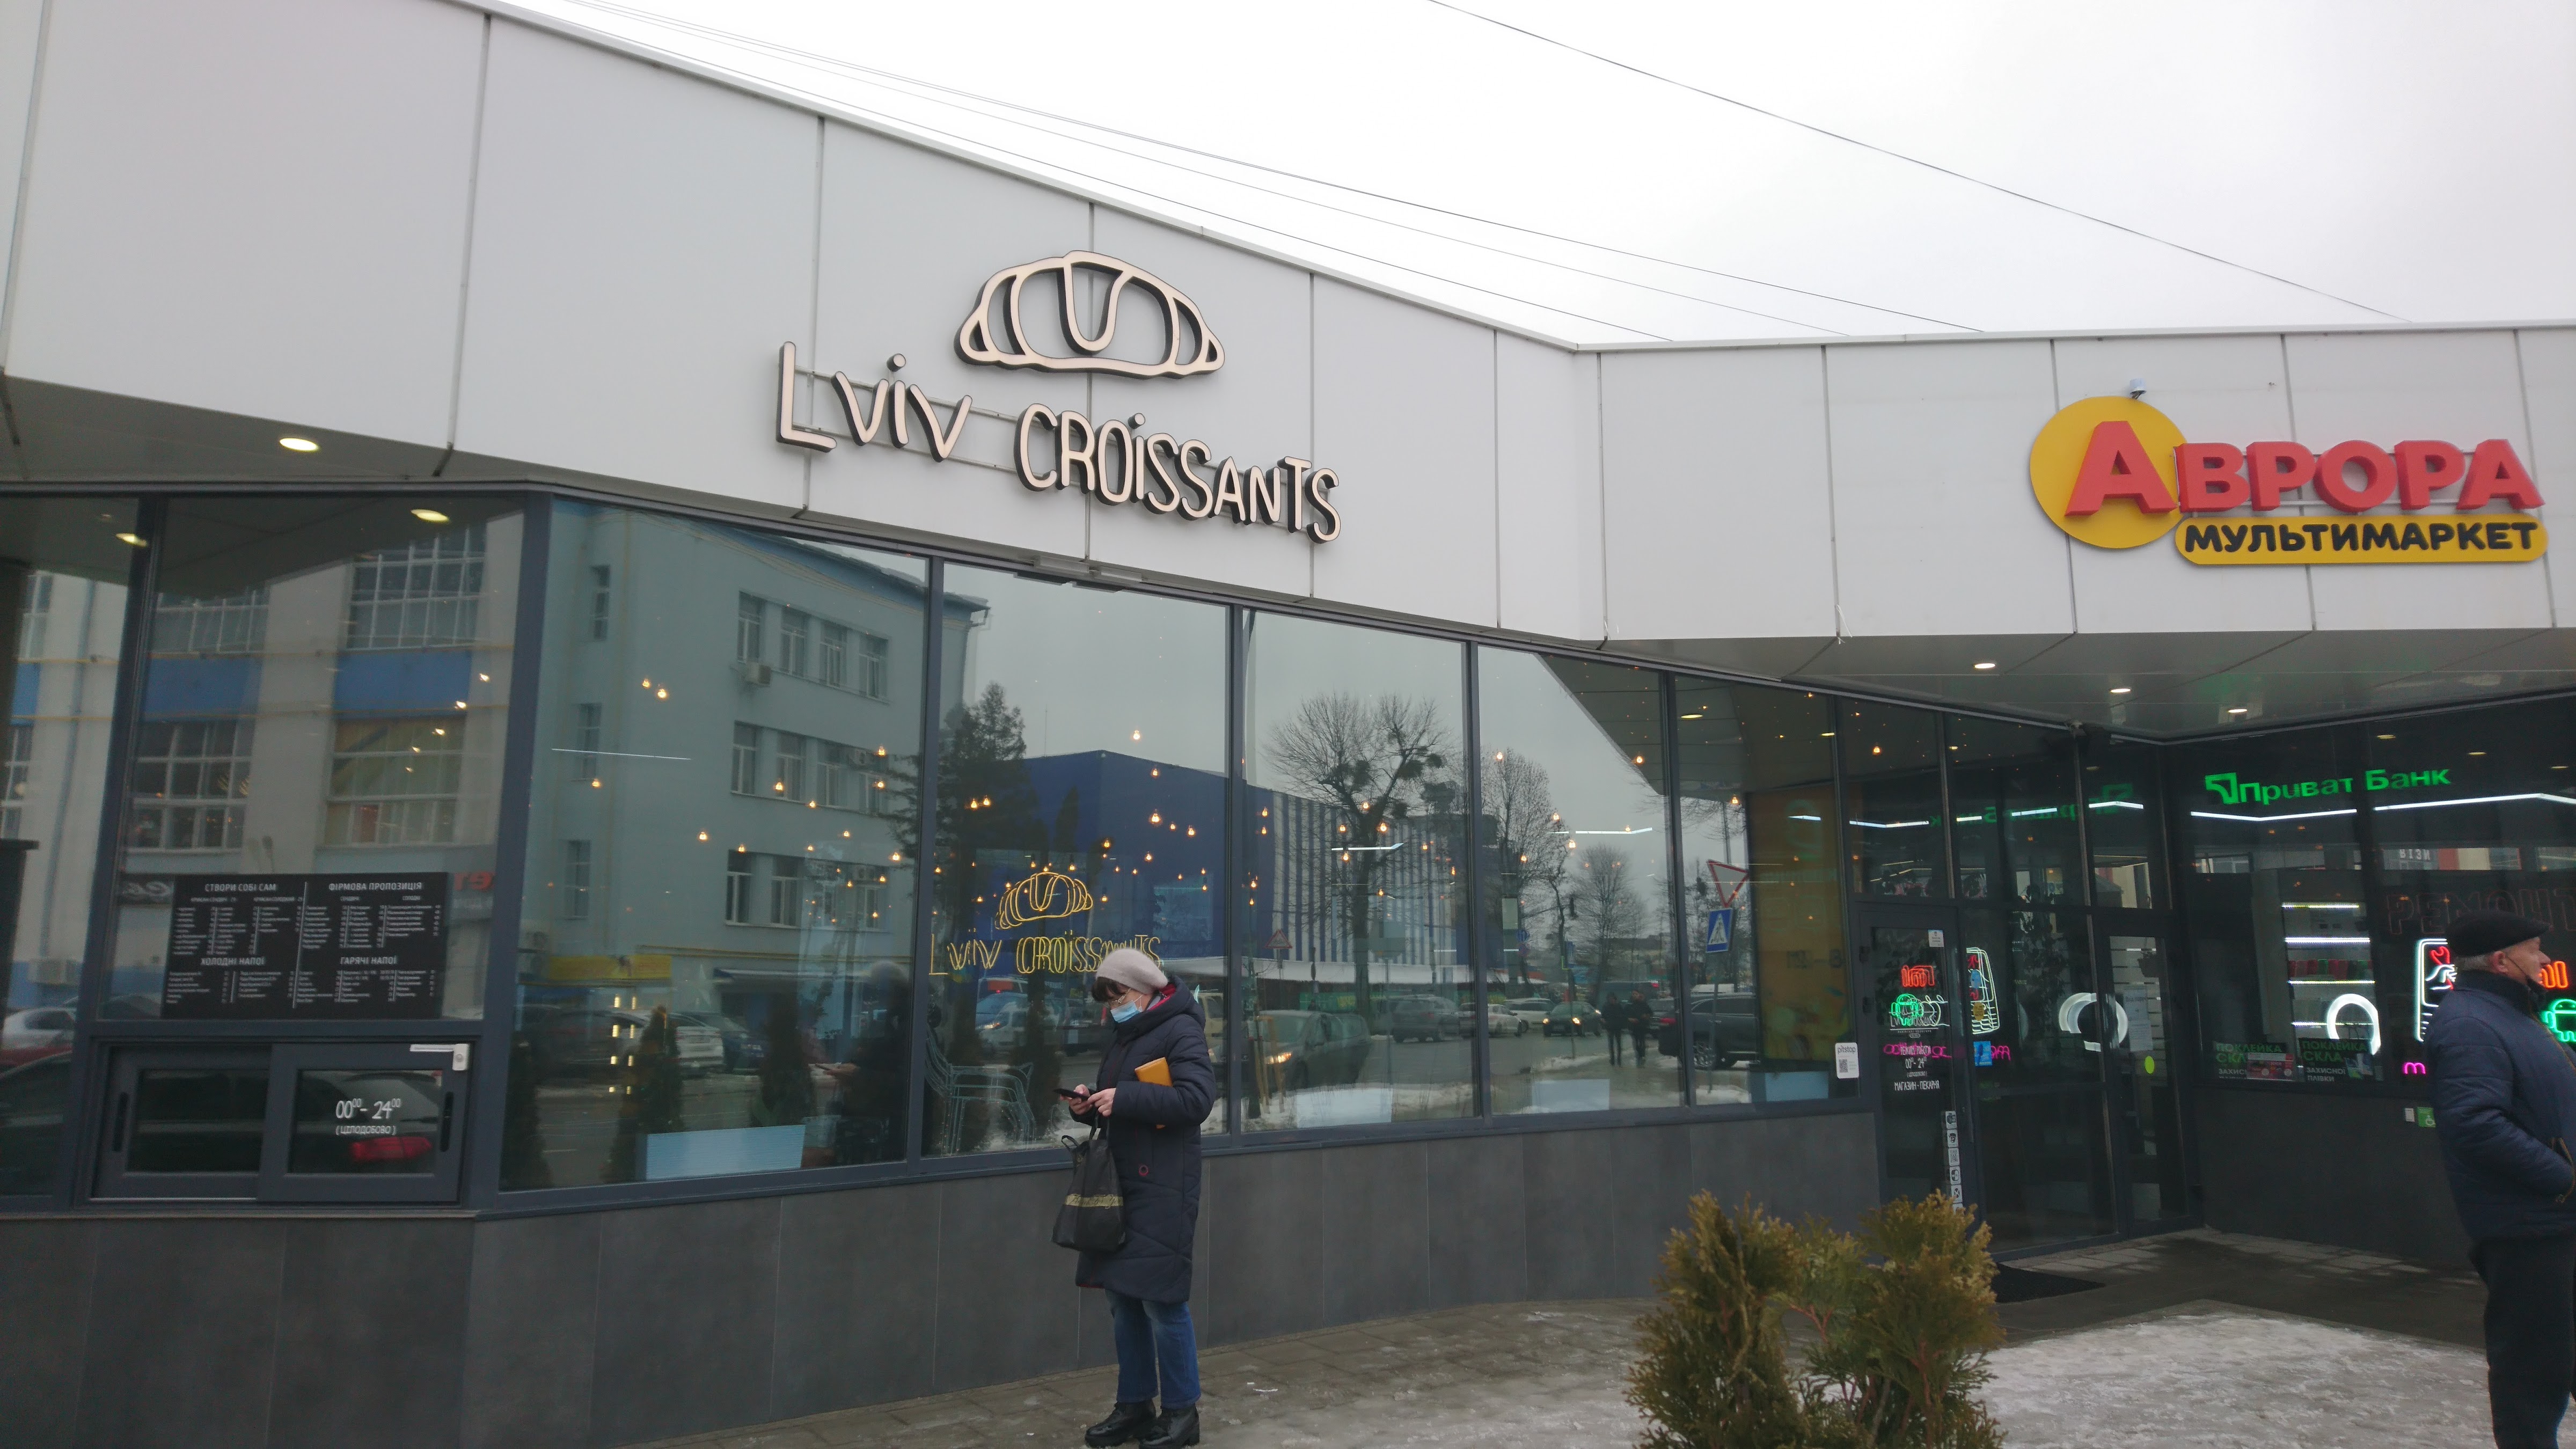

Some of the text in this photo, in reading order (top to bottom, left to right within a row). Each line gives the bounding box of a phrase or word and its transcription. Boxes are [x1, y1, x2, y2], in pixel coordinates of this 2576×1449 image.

[2064, 421, 2545, 517] АВРОРА
[2184, 522, 2538, 553] МУЛЬТИМАРКЕТ
[2365, 769, 2452, 791] Банк
[205, 883, 277, 891] СТВОРИ СОБІ САМ
[328, 882, 423, 891] ФІРМОВА ПРОПОЗИЦІЯ
[200, 956, 265, 966] ХОЛОДНІ НАПОЇ
[340, 955, 397, 964] ГАРЯЧІ НАПОЇ
[1838, 1045, 1856, 1055] pitstop
[2216, 1042, 2282, 1052] ПОКЛЕЙКА
